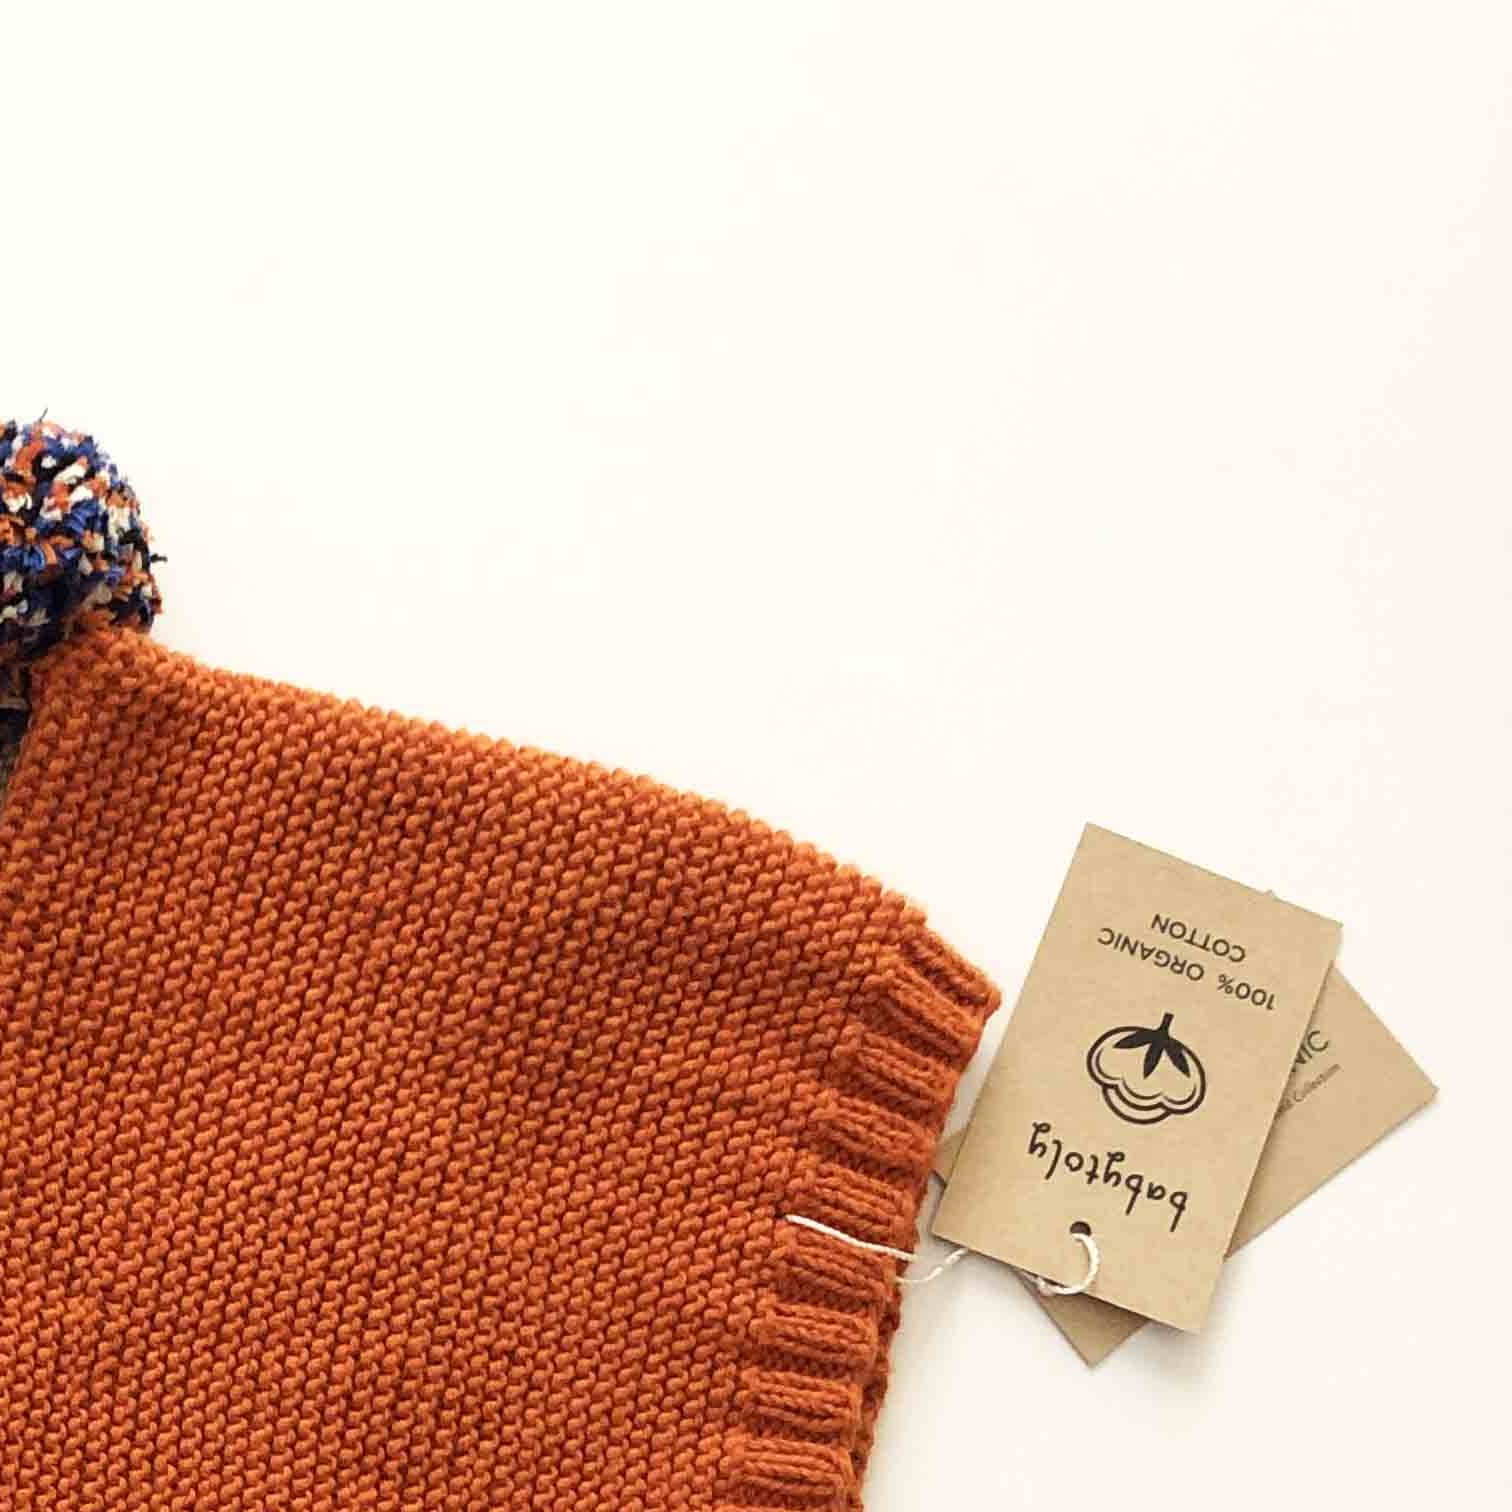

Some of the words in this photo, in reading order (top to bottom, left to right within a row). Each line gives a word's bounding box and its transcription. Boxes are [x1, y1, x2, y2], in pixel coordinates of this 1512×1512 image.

[1097, 927, 1205, 981] ORGANIC
[1151, 913, 1246, 963] COTTON
[1217, 973, 1275, 1010] 100%
[1028, 1122, 1188, 1232] babytoly
